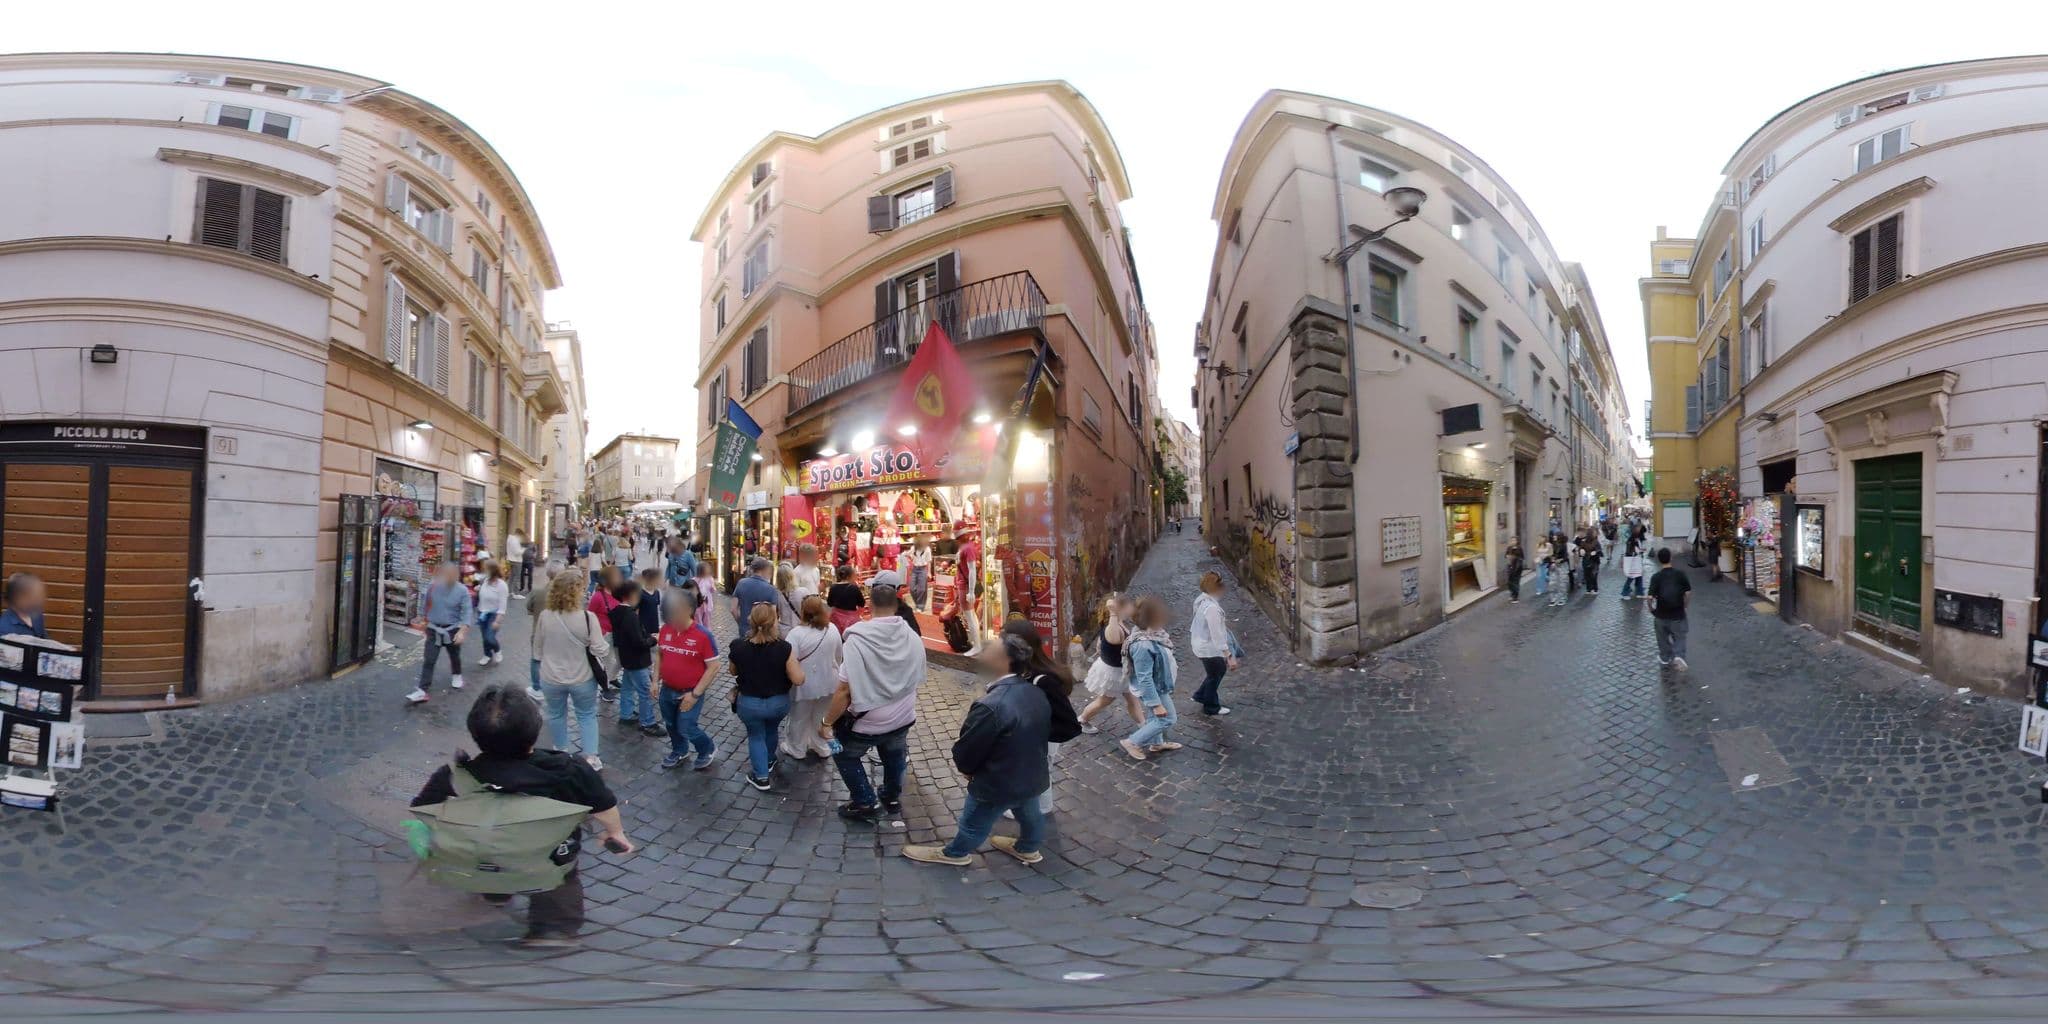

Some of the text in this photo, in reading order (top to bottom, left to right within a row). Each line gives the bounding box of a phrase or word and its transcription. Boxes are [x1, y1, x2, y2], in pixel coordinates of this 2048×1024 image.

[54, 426, 147, 440] PICCOLO BUCO
[810, 448, 921, 491] Sport Sto
[879, 471, 926, 484] PRODUC
